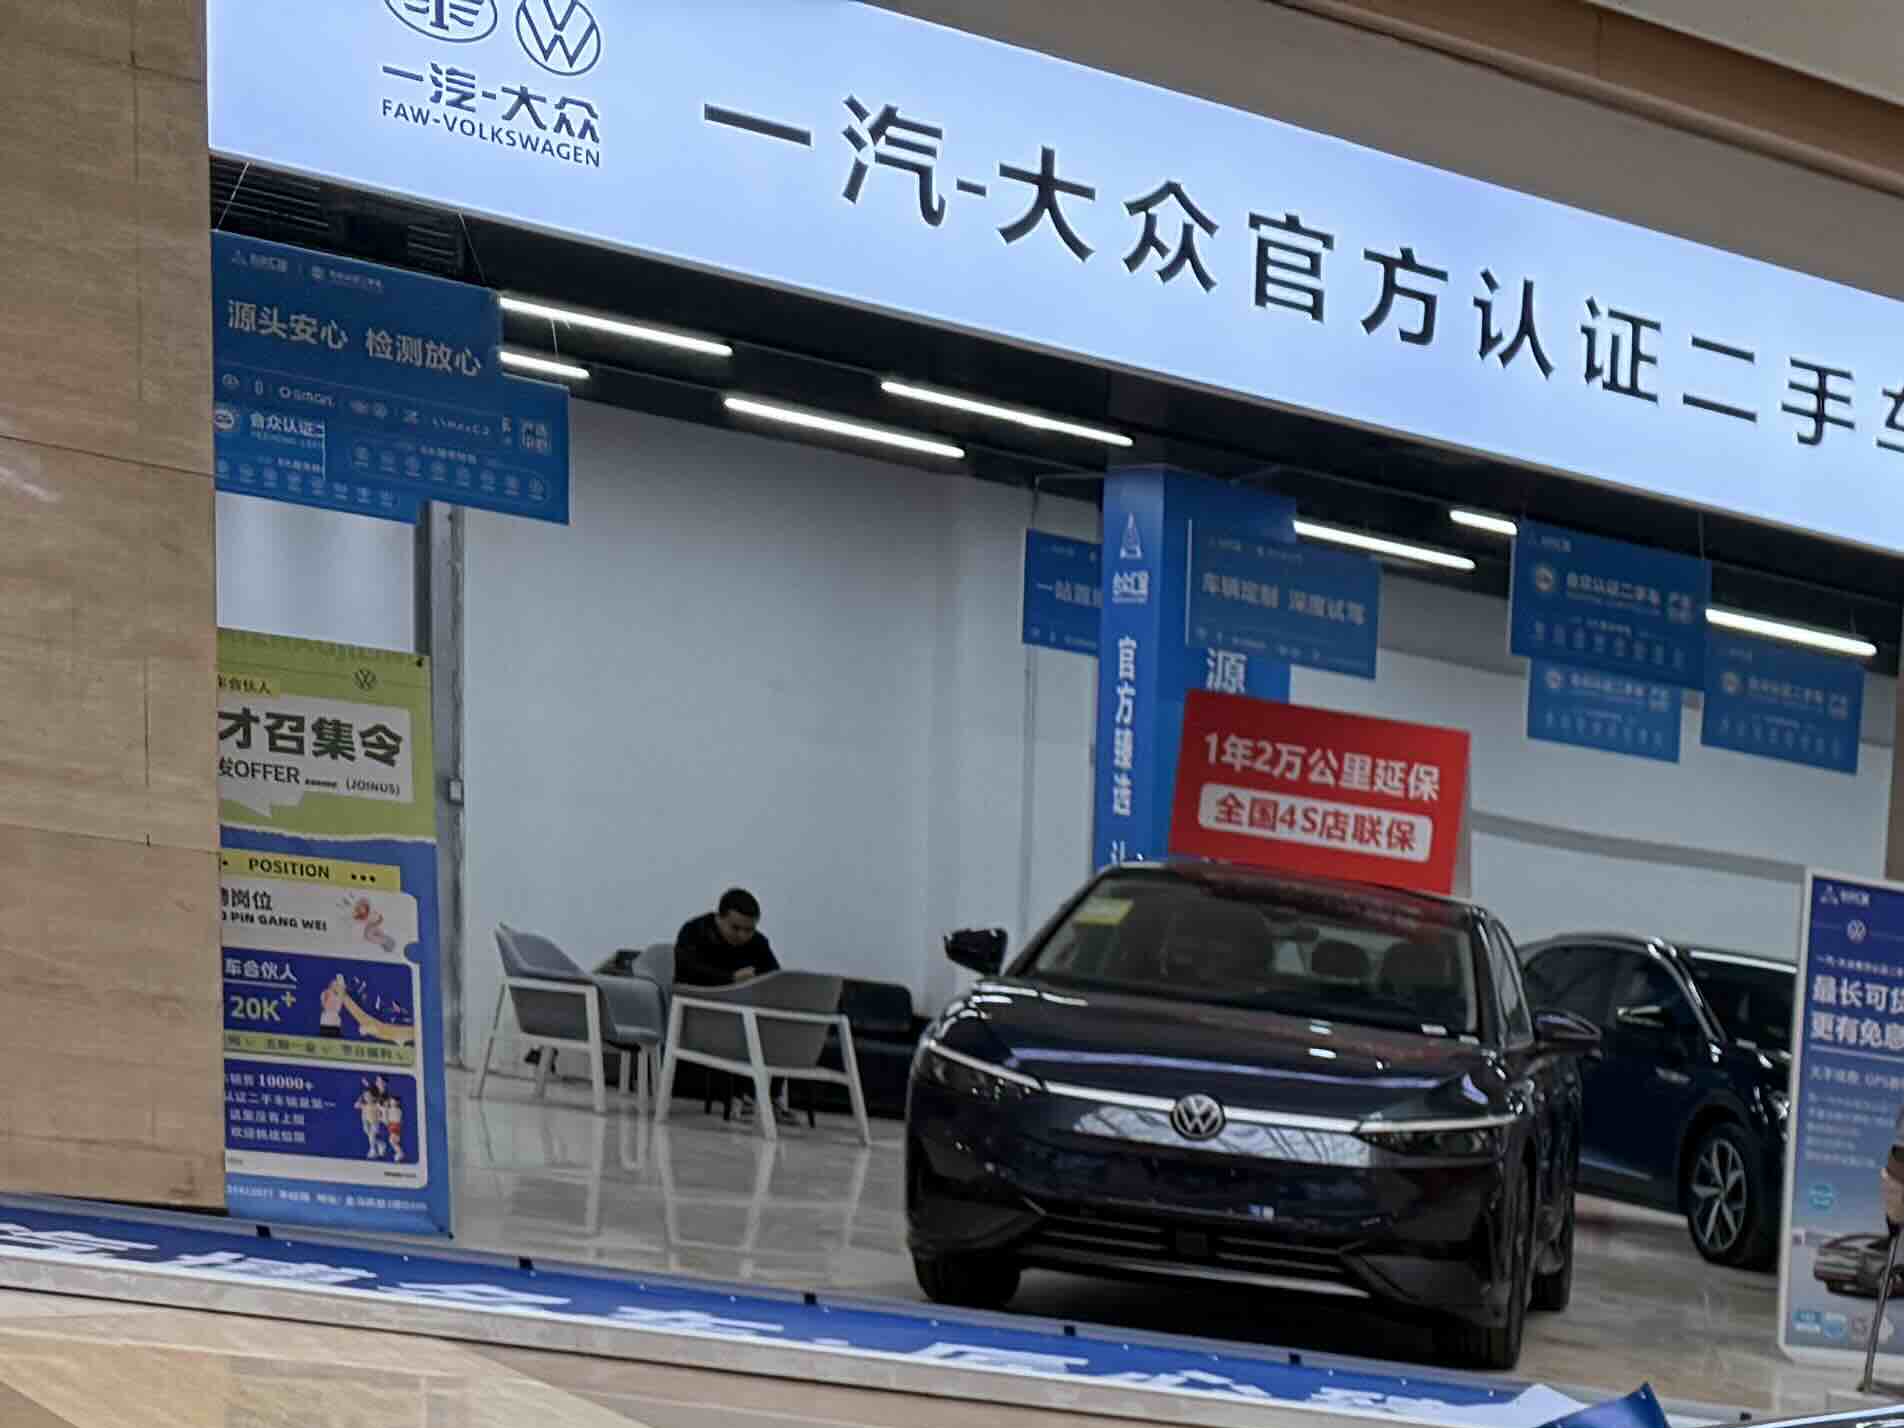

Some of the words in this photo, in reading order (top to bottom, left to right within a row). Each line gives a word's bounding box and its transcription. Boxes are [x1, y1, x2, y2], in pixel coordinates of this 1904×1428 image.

[382, 99, 600, 168] FAW-VOLKSWAGEN
[228, 299, 348, 350] 源头安心
[365, 327, 481, 377] 检测放心
[1205, 733, 1441, 802] 1年2万公里延保
[1215, 793, 1417, 852] 全国4S店联保
[249, 857, 330, 880] POSITION
